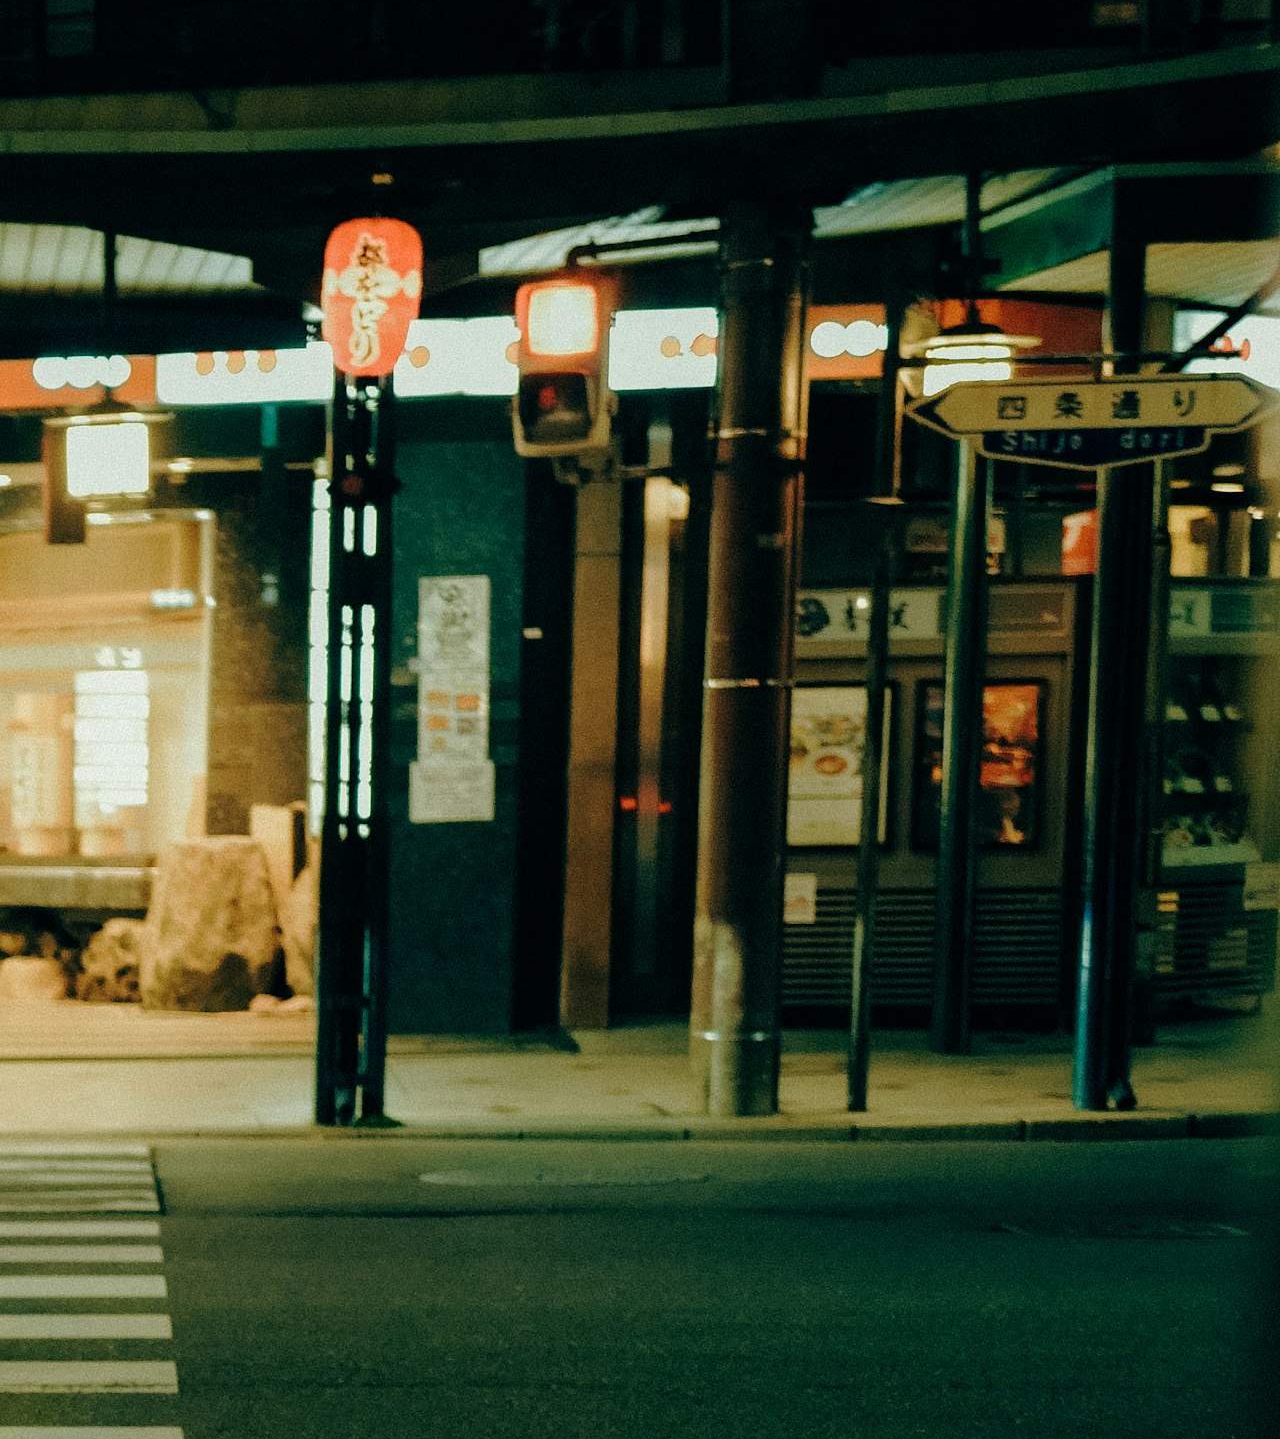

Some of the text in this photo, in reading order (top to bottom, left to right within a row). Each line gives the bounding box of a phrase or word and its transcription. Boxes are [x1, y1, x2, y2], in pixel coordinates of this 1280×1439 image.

[997, 390, 1195, 420] 四条通り
[1001, 428, 1185, 453] Shijo dori
